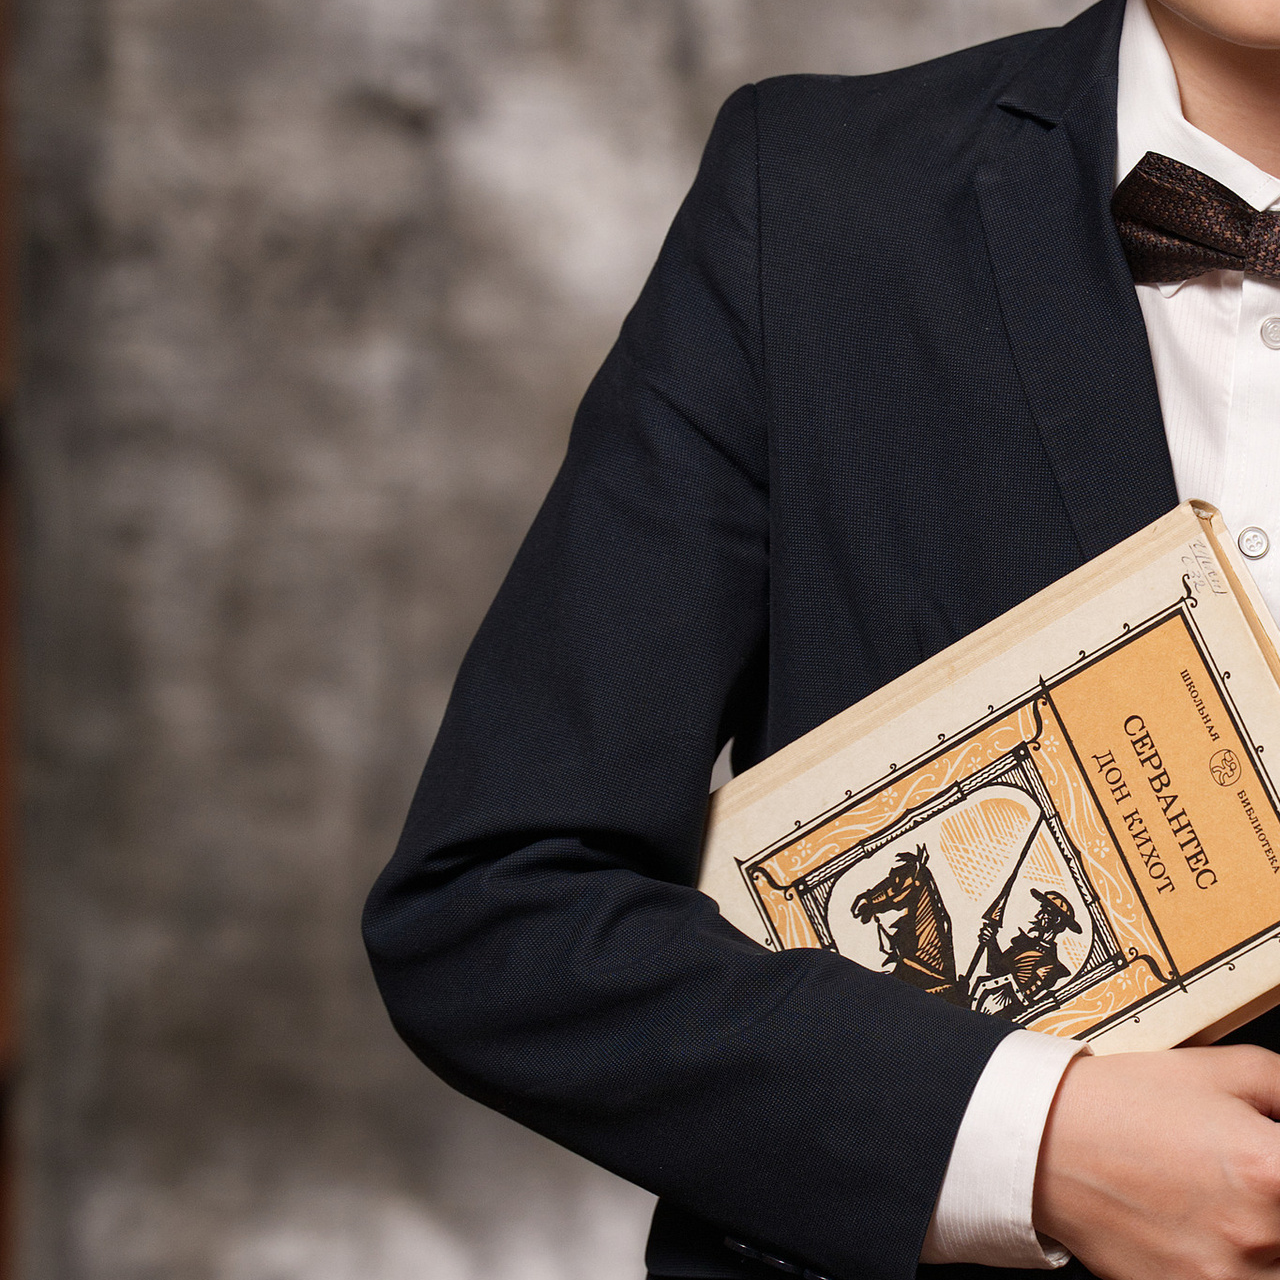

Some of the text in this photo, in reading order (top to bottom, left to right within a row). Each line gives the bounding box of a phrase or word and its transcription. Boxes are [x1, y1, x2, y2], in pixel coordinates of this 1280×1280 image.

[1091, 749, 1176, 895] ДОН КИХОТ
[1123, 714, 1219, 890] СЕРВАНТЕС
[1179, 668, 1280, 874] ШКОЛЬНАЯ БИБЛИОТЕКА
